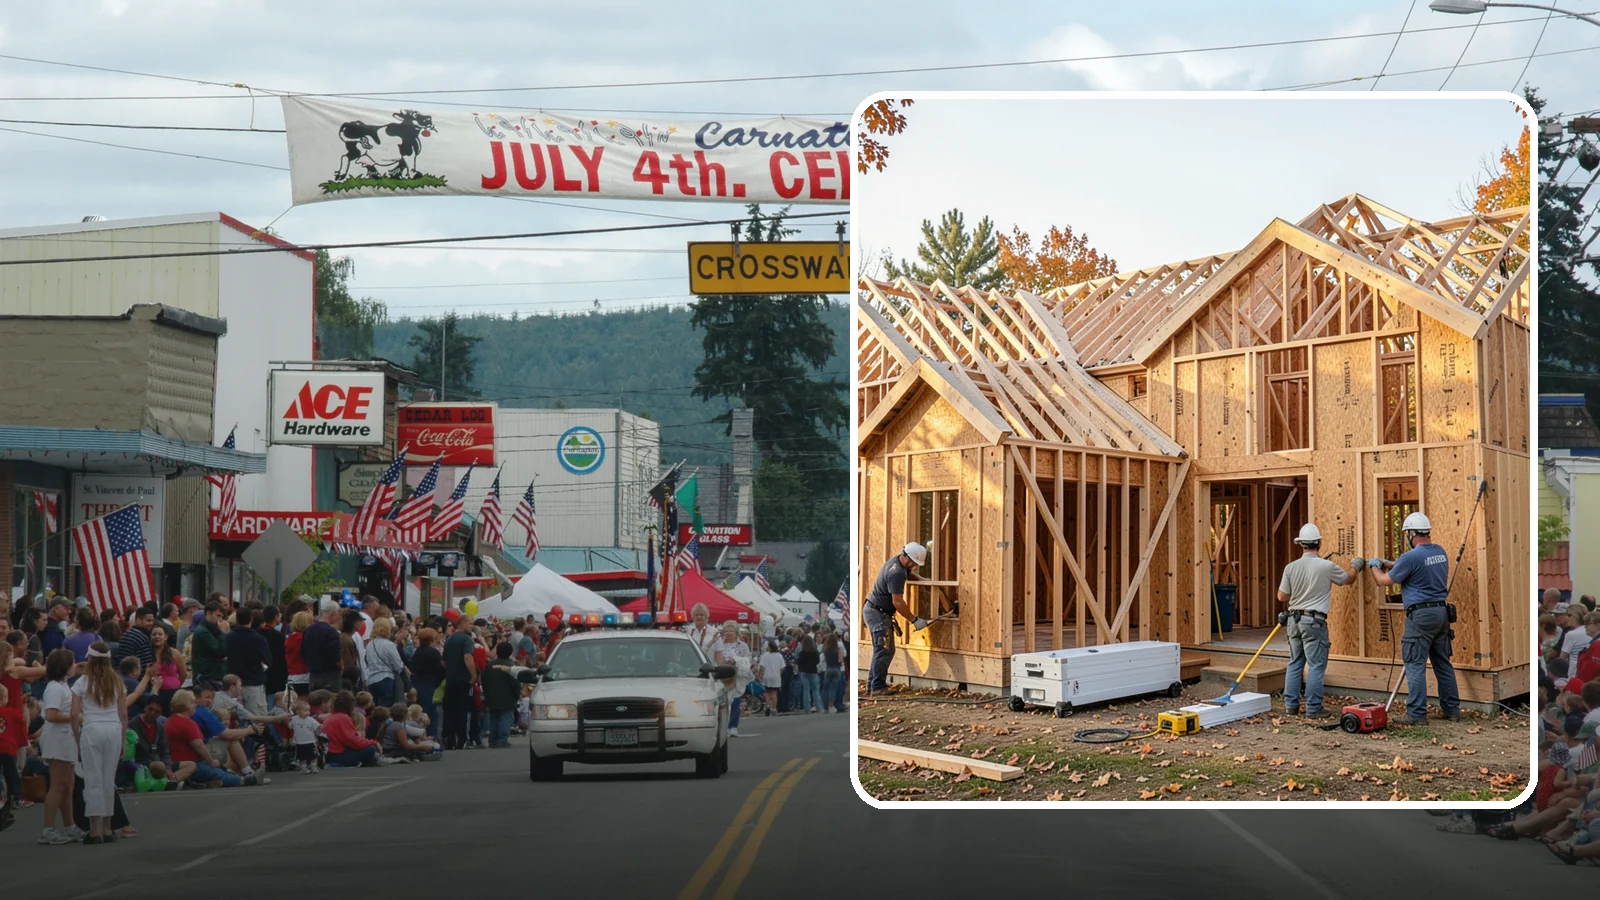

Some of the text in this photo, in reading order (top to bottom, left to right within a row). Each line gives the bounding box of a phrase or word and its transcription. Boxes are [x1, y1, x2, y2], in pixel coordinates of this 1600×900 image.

[481, 140, 604, 191] JULY
[632, 149, 746, 198] 4th.
[697, 254, 850, 280] CROSSWA
[283, 380, 373, 420] ACE
[406, 409, 486, 422] CEDAR LOG
[283, 421, 370, 436] Hardware
[416, 428, 477, 447] Coca-Cola
[353, 466, 385, 480] Simpl
[83, 484, 155, 495] St. Vincent de Paul
[688, 526, 741, 536] CRNATION
[699, 535, 730, 543] GLASS
